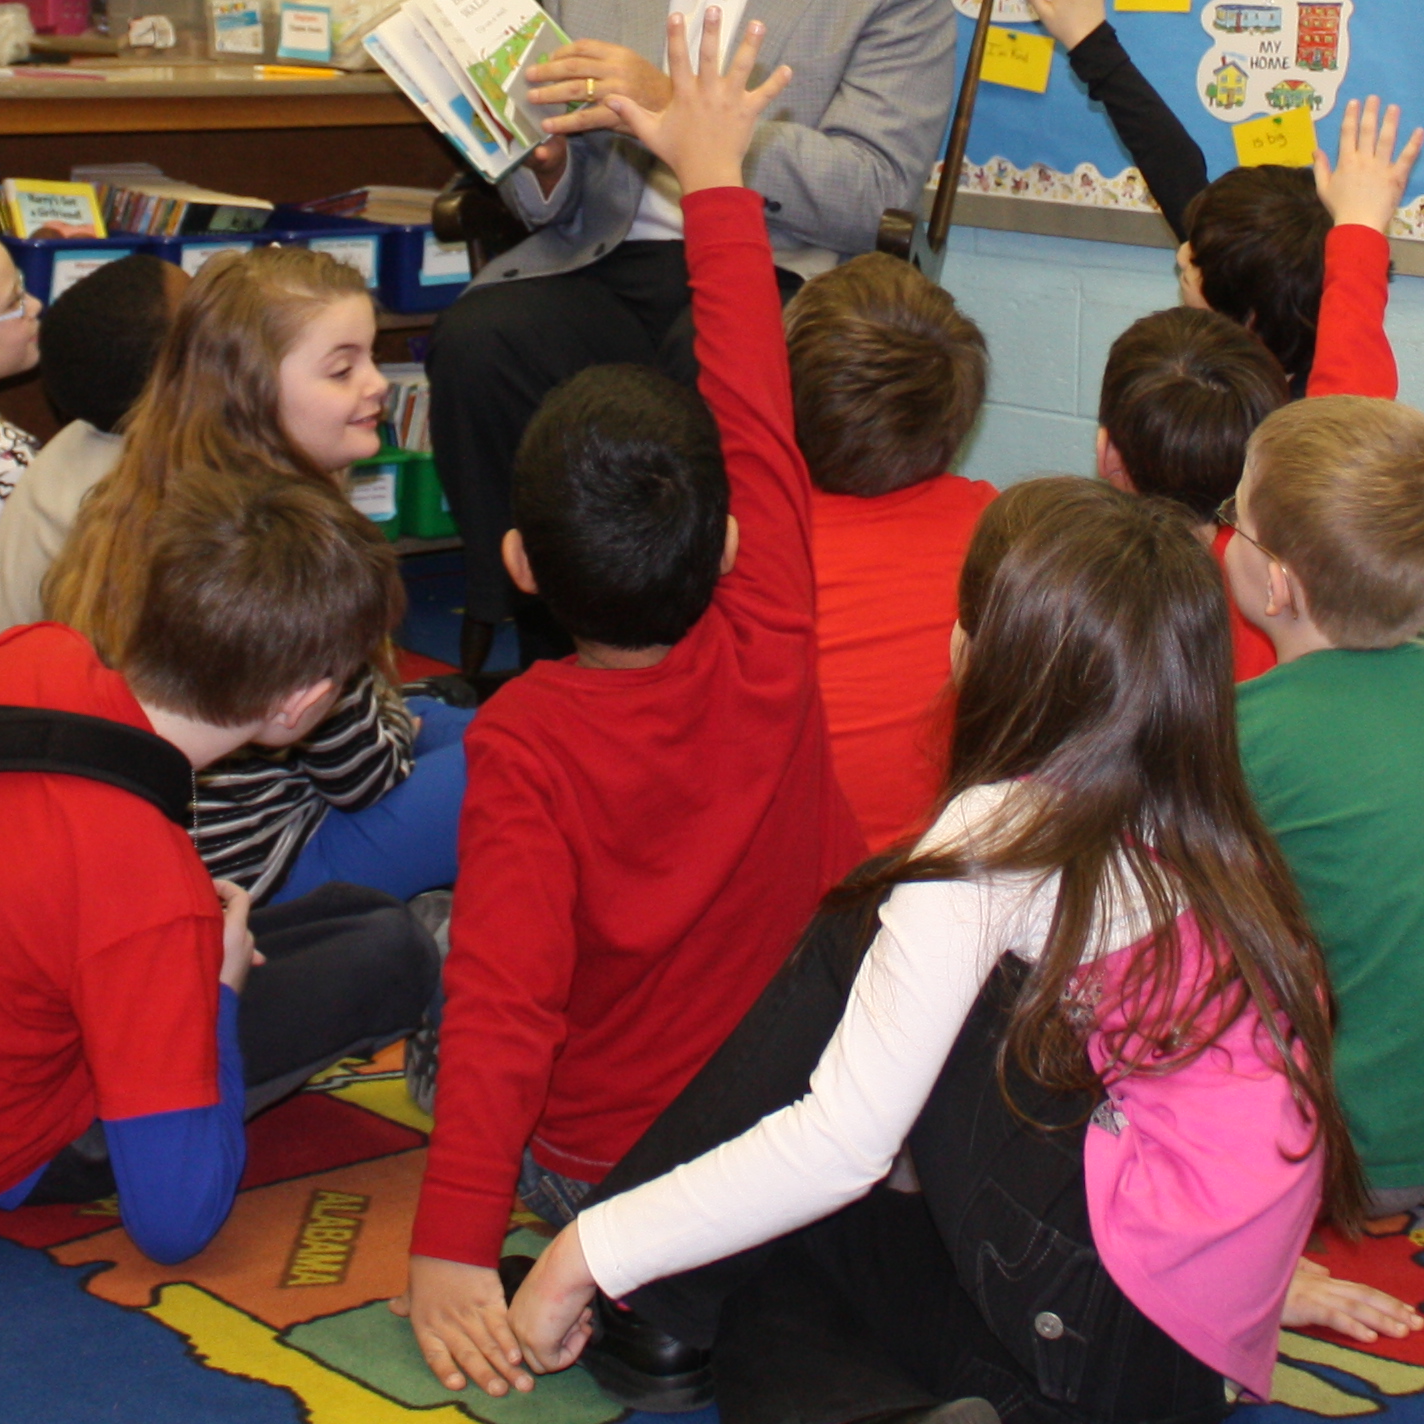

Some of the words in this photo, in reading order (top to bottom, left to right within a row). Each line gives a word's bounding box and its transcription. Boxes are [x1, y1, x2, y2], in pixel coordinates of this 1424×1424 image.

[1260, 41, 1282, 54] MY
[1250, 56, 1290, 70] HOME
[287, 1190, 366, 1286] ALABAMA
